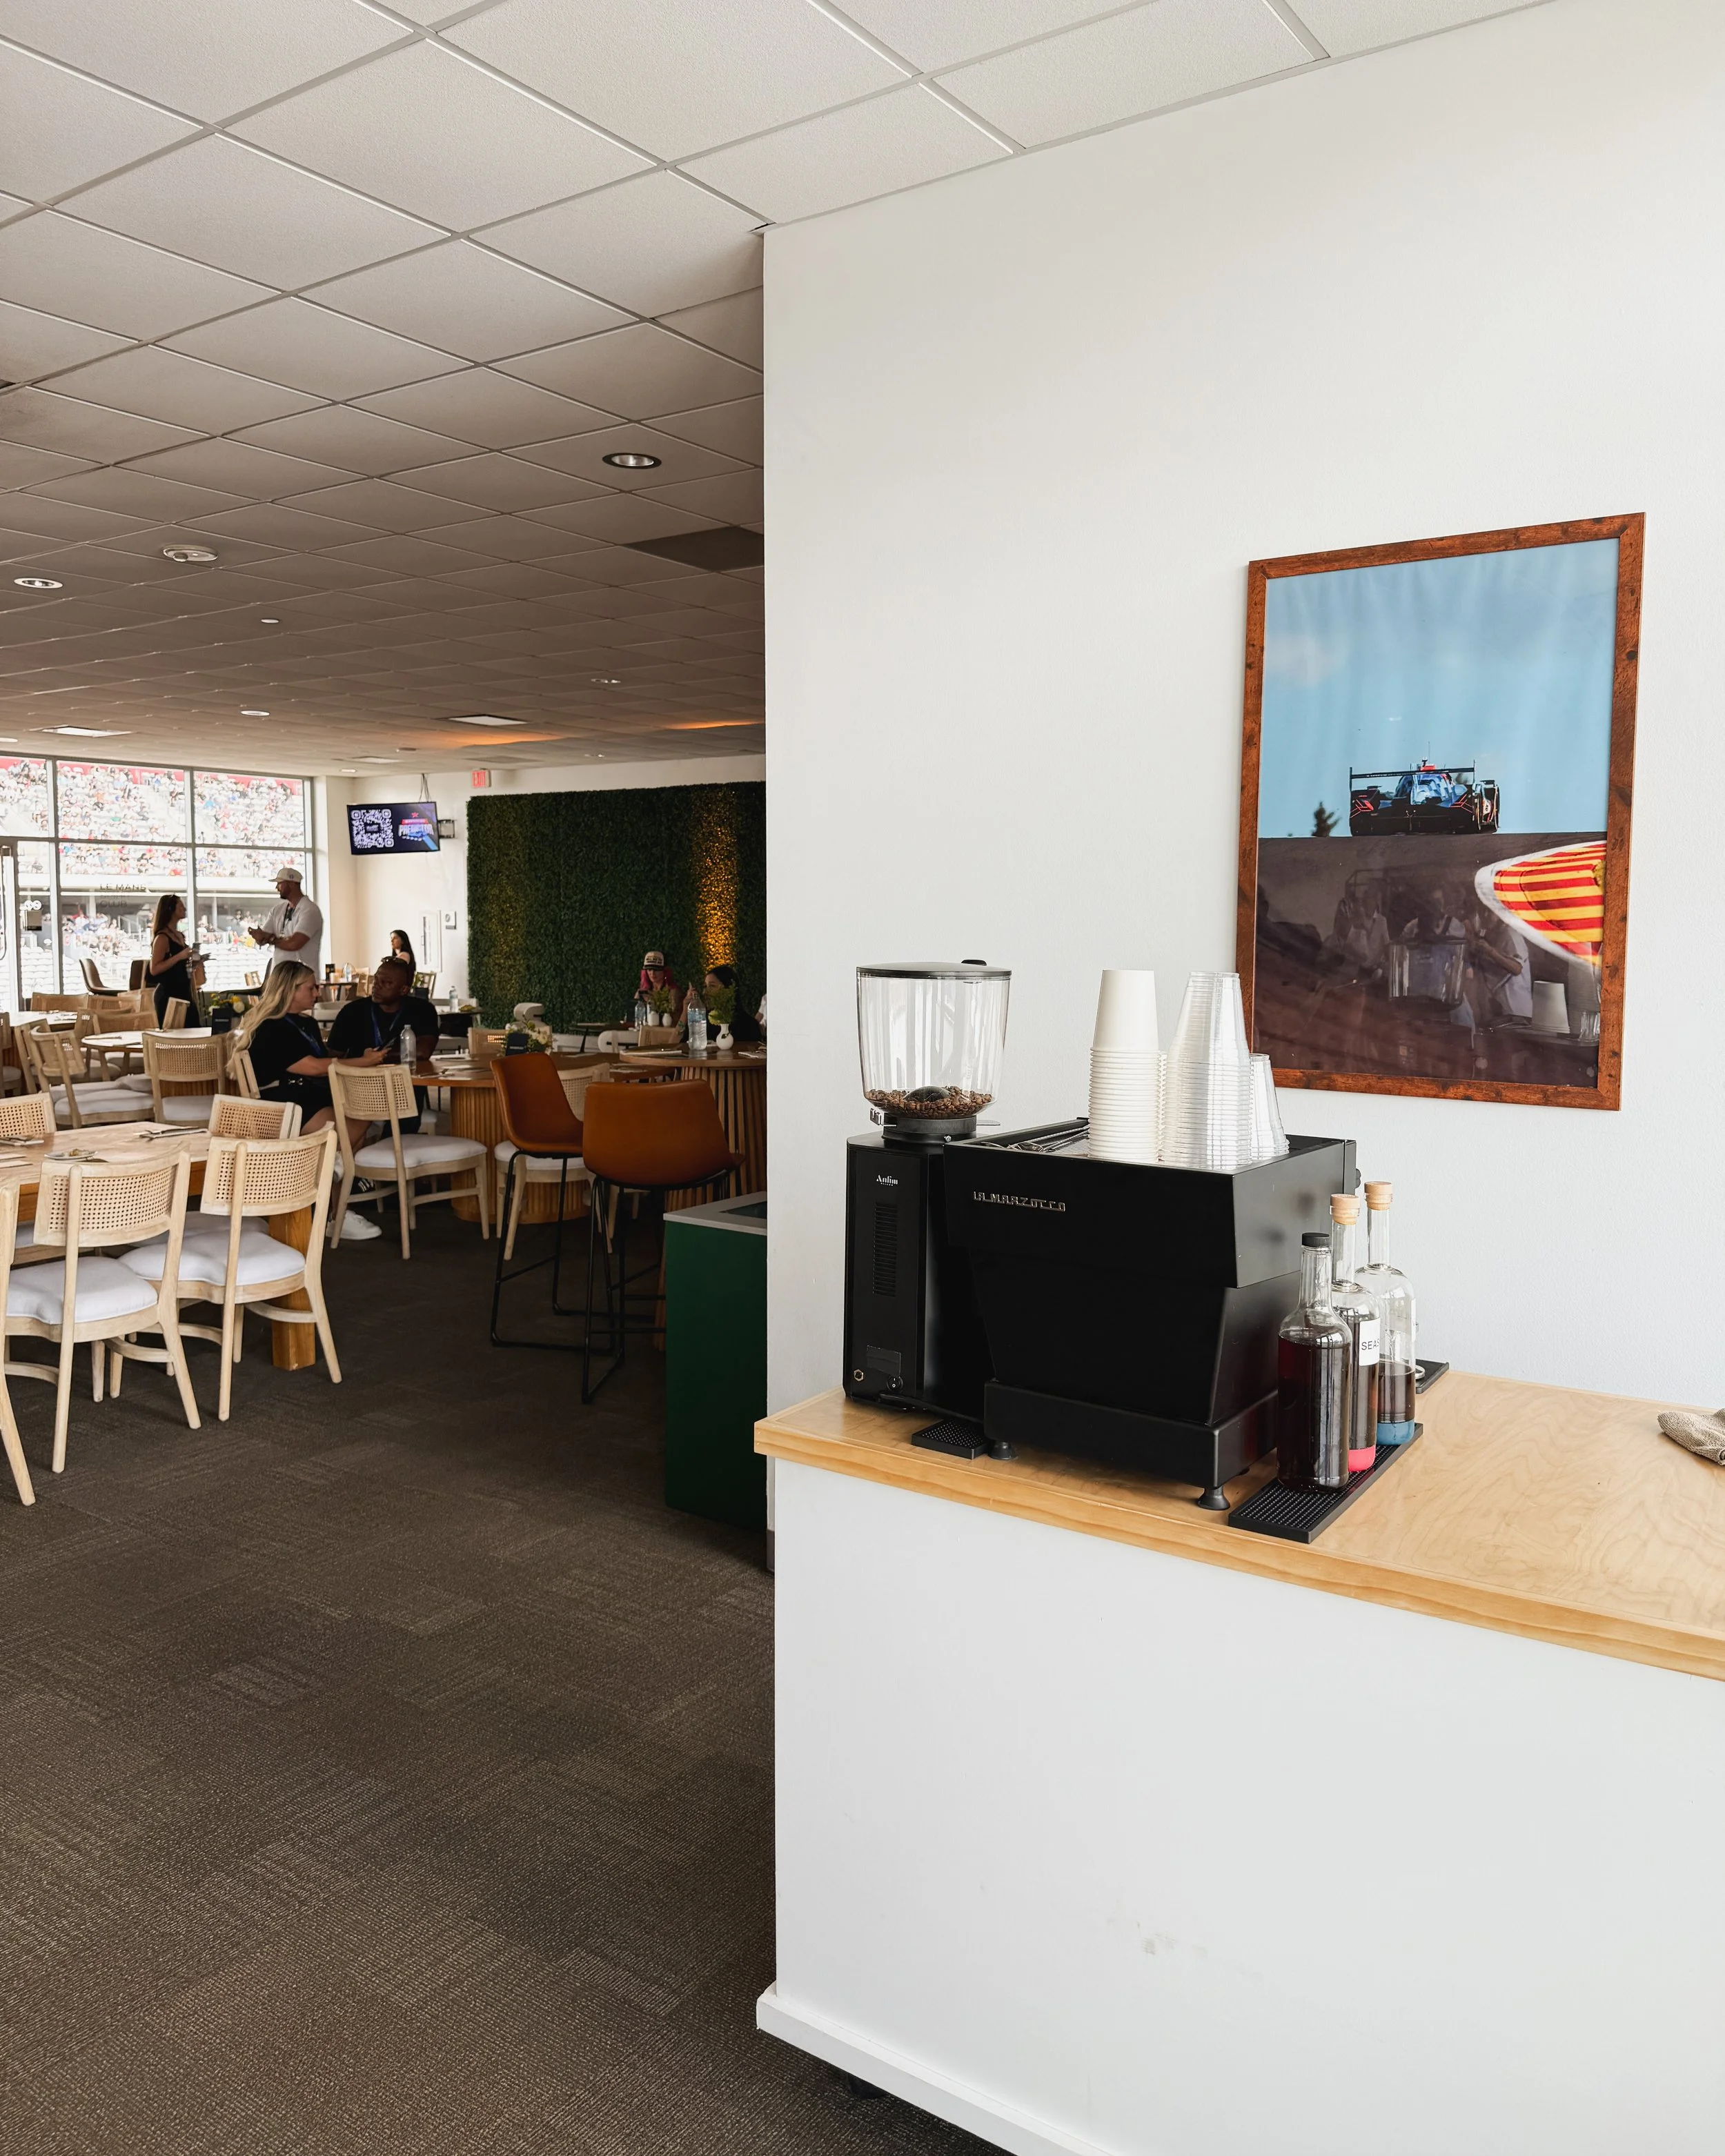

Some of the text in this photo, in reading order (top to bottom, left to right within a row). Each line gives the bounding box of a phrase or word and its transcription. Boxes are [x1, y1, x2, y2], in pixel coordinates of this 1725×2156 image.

[99, 883, 146, 892] LE MANS
[99, 900, 128, 908] CLUB
